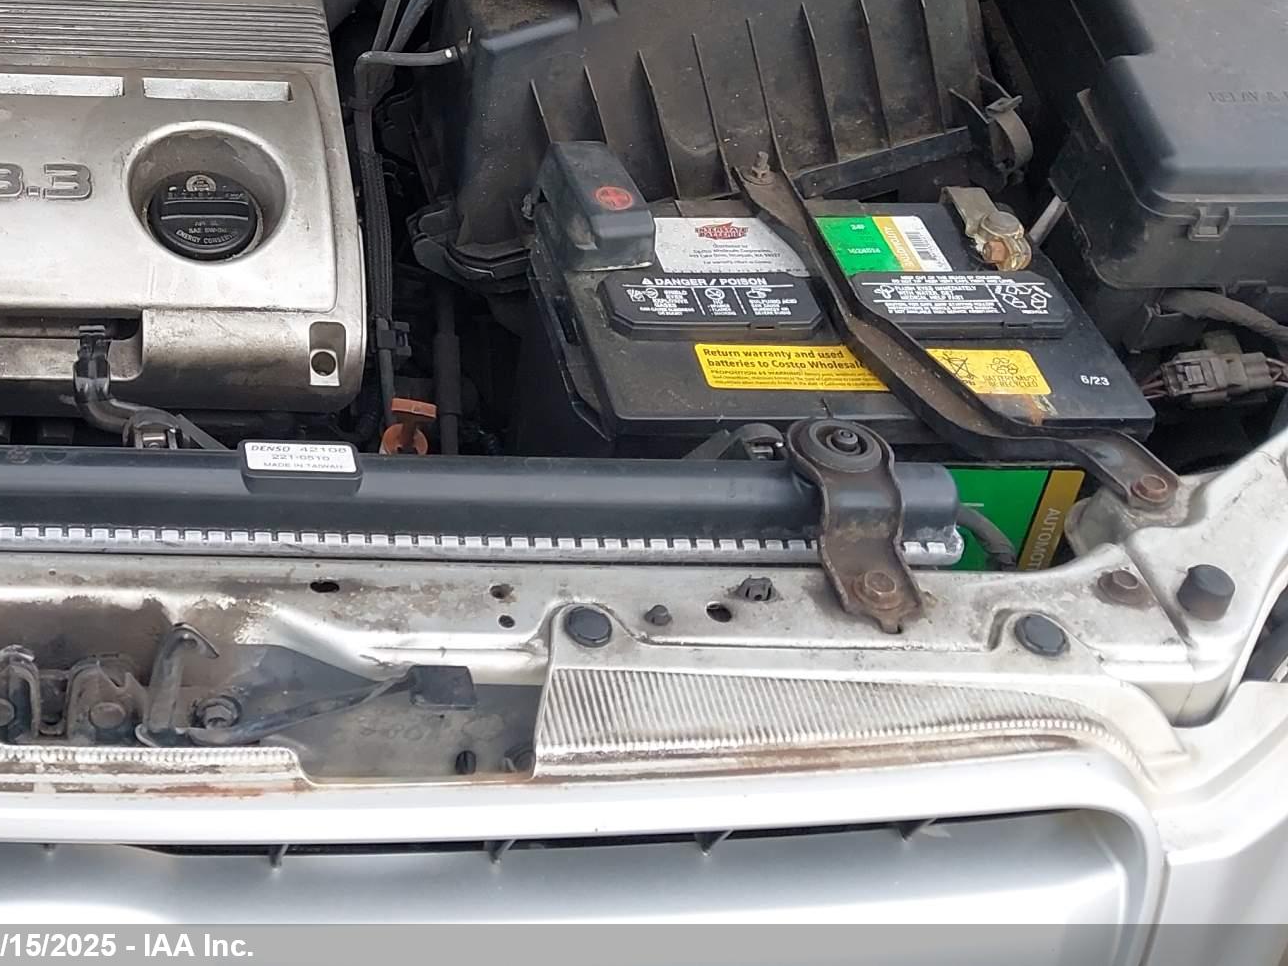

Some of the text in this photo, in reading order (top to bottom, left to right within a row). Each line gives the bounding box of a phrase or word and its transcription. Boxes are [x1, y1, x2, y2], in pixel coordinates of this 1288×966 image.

[655, 278, 708, 286] DANGER
[719, 278, 768, 286] POISON
[703, 348, 844, 360] Return warranty and used
[707, 358, 756, 368] batteries
[758, 359, 769, 368] to
[772, 359, 807, 369] Costco
[1080, 375, 1110, 386] 6/23
[251, 445, 291, 453] DENSO
[1027, 507, 1062, 571] AUTOMOT
